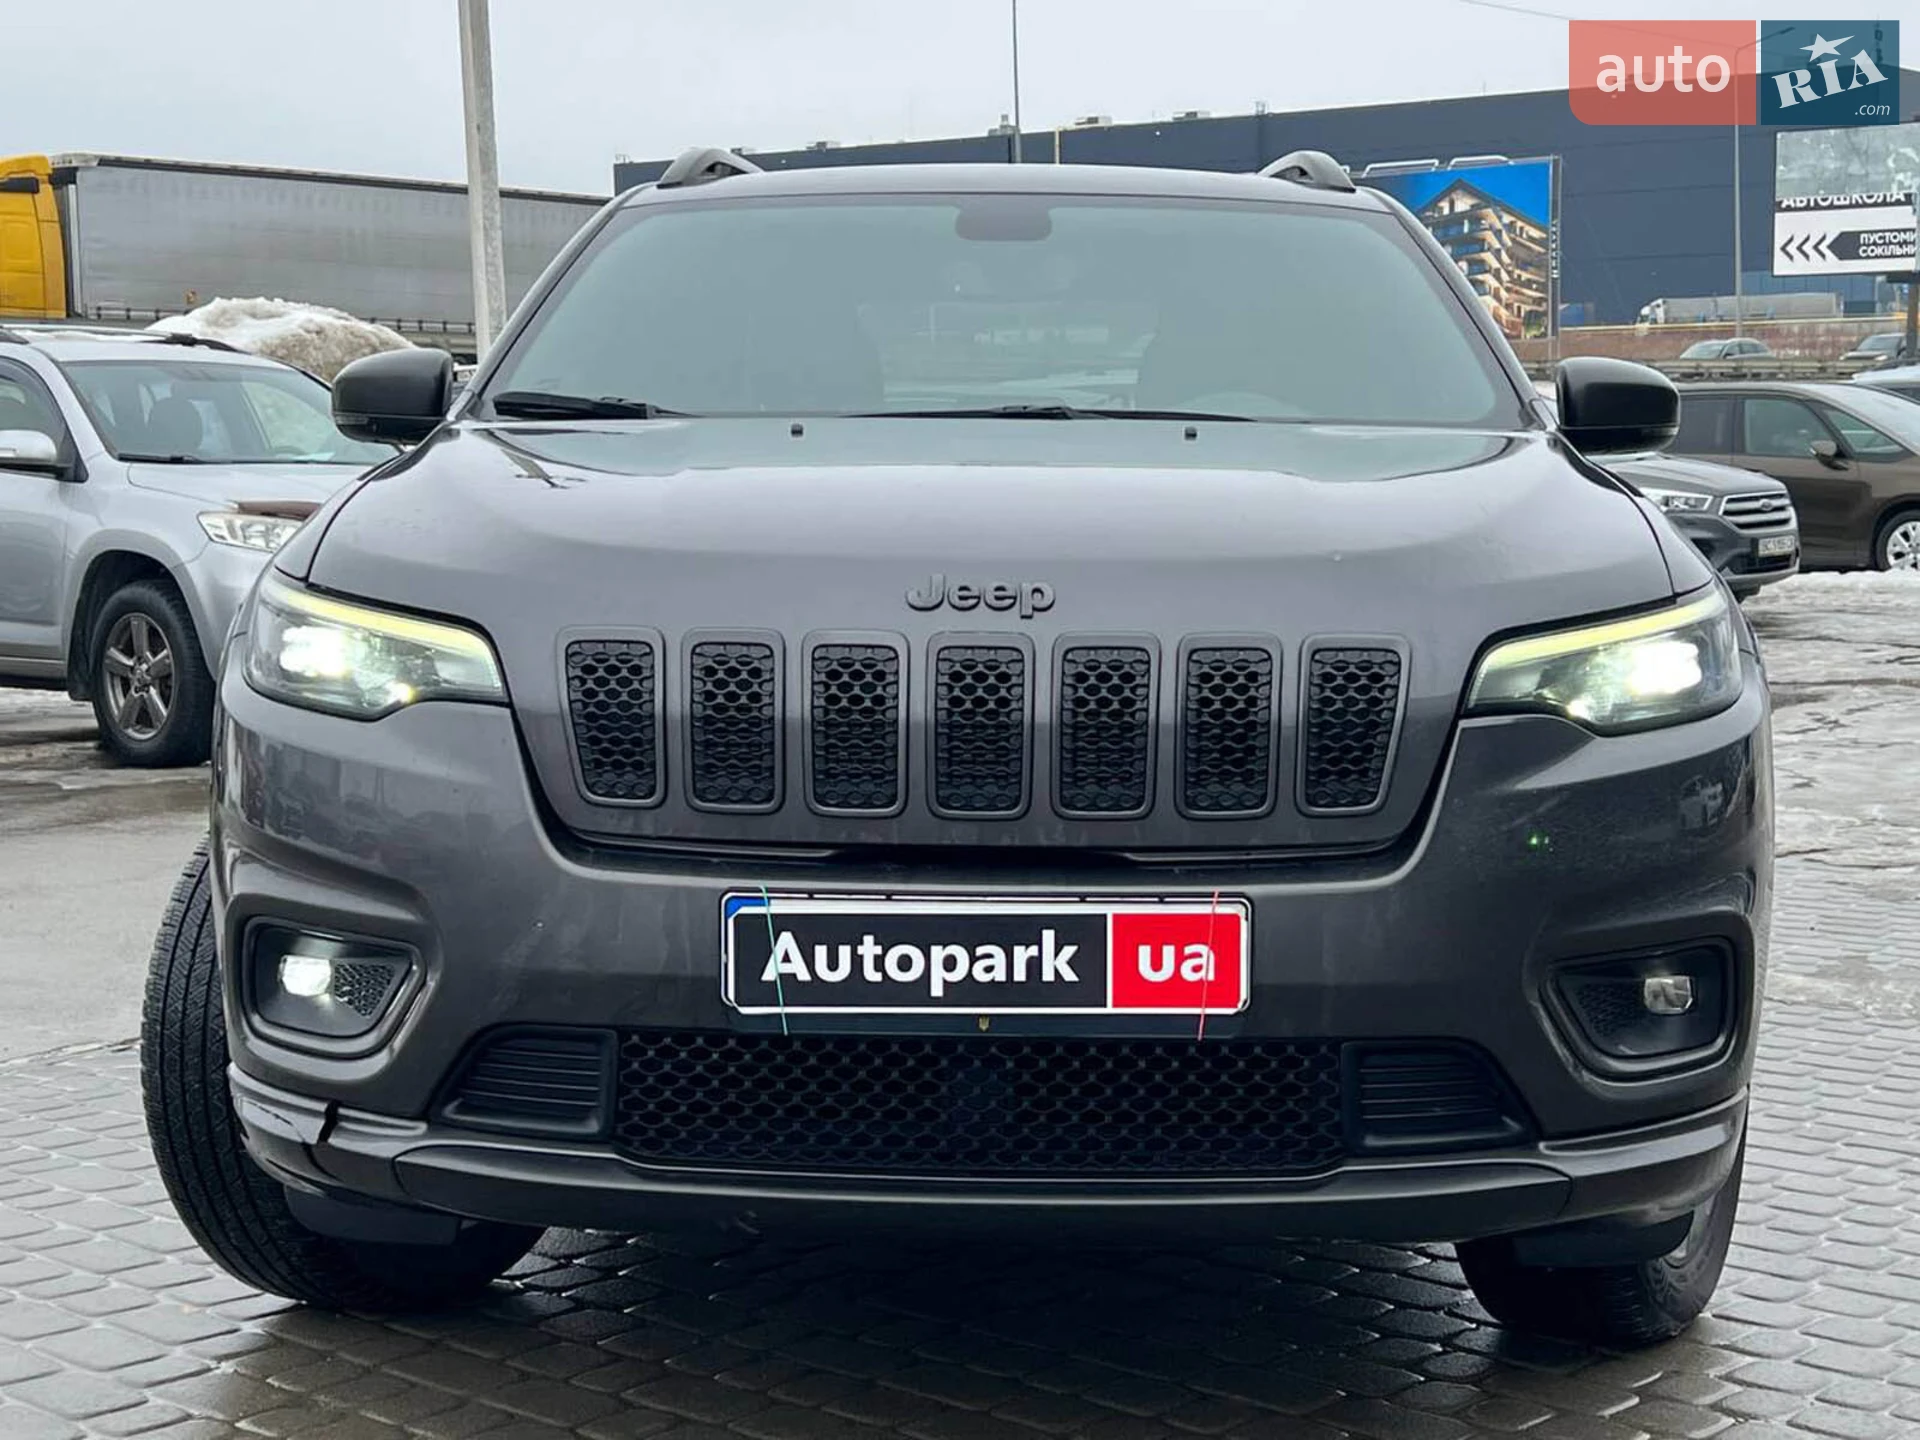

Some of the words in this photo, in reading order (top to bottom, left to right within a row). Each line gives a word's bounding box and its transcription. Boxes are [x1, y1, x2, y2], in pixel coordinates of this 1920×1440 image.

[905, 573, 1056, 619] Jeep
[761, 929, 1080, 998] Autopark
[1137, 943, 1215, 982] ua
